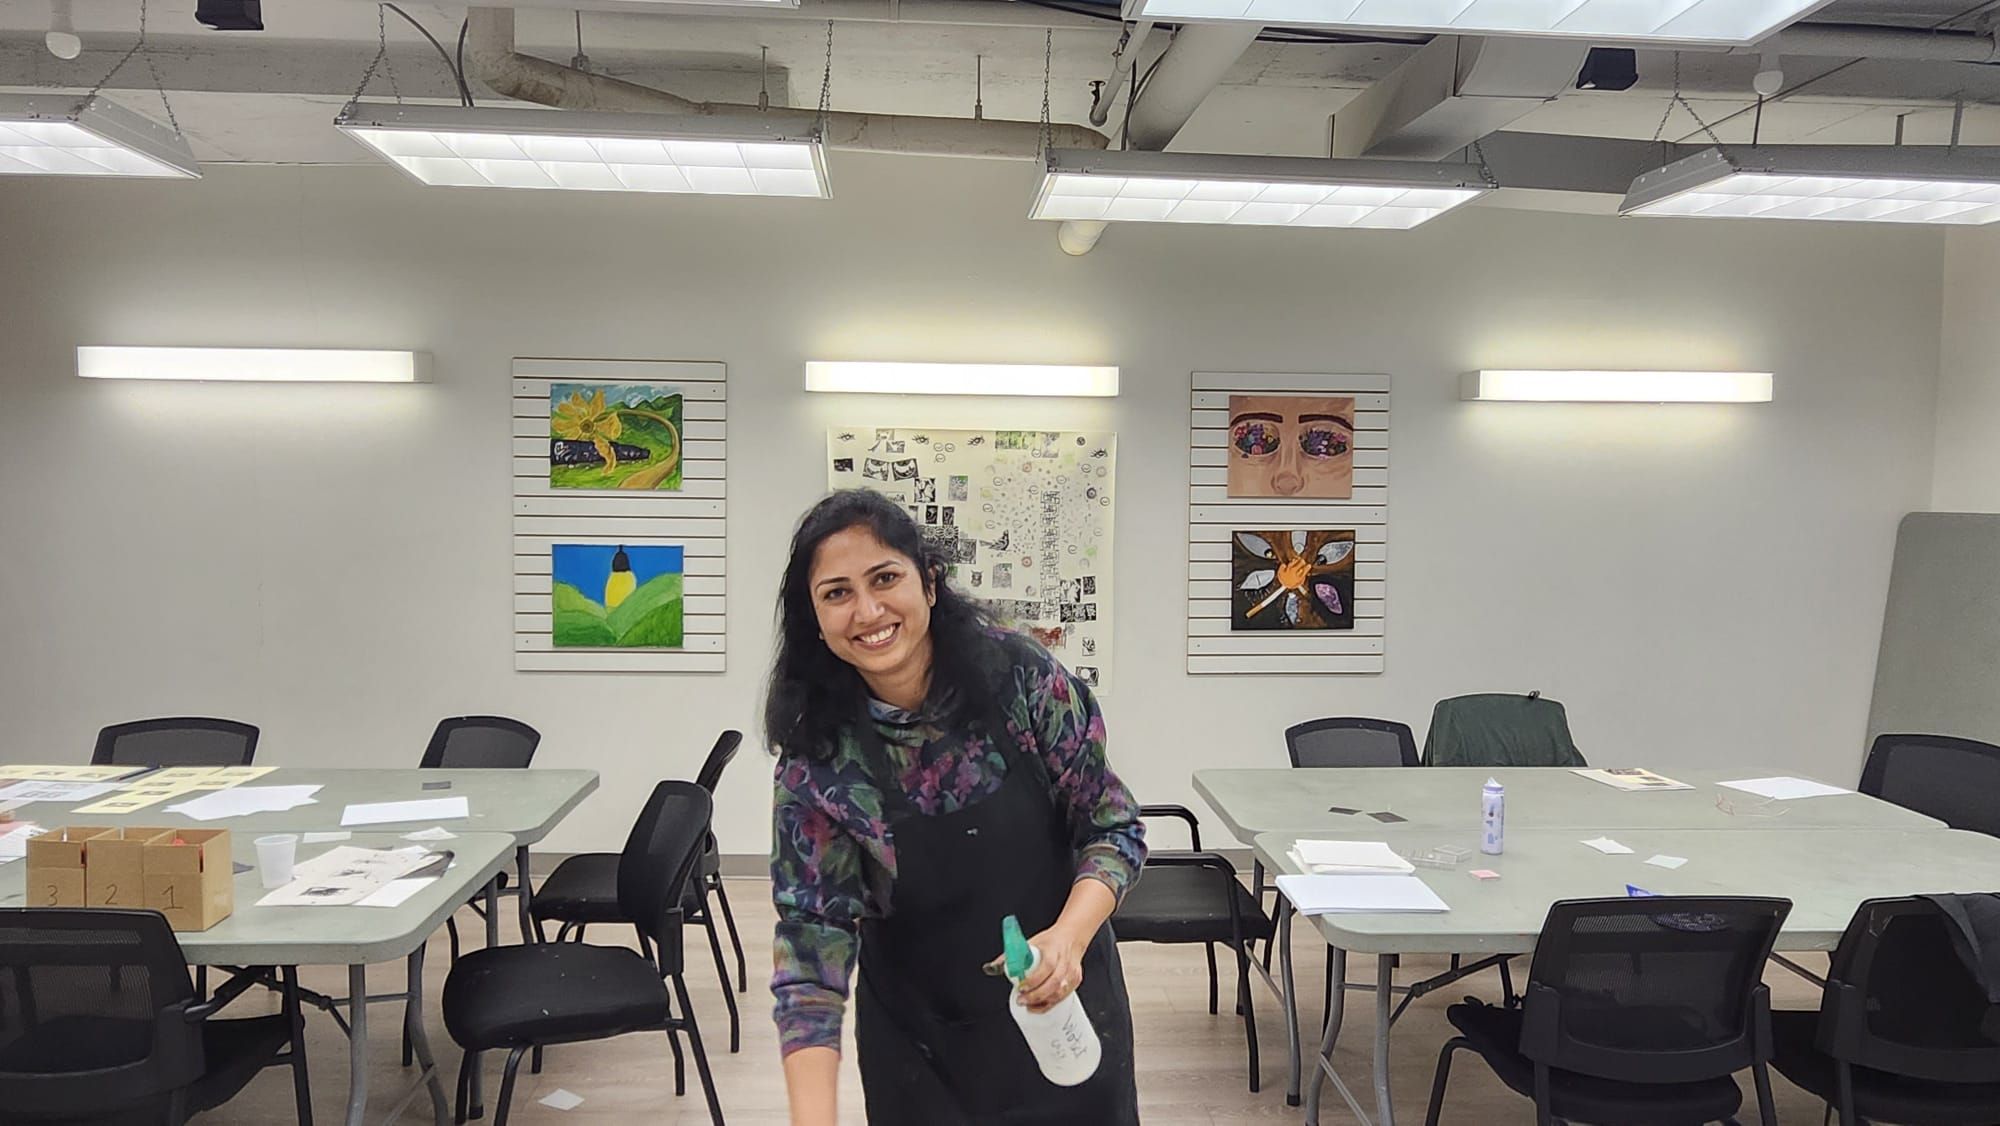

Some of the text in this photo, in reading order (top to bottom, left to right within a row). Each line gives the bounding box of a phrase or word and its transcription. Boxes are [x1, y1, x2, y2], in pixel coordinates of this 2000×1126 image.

[47, 884, 59, 907] 3
[104, 883, 119, 906] 2
[161, 884, 185, 911] 1
